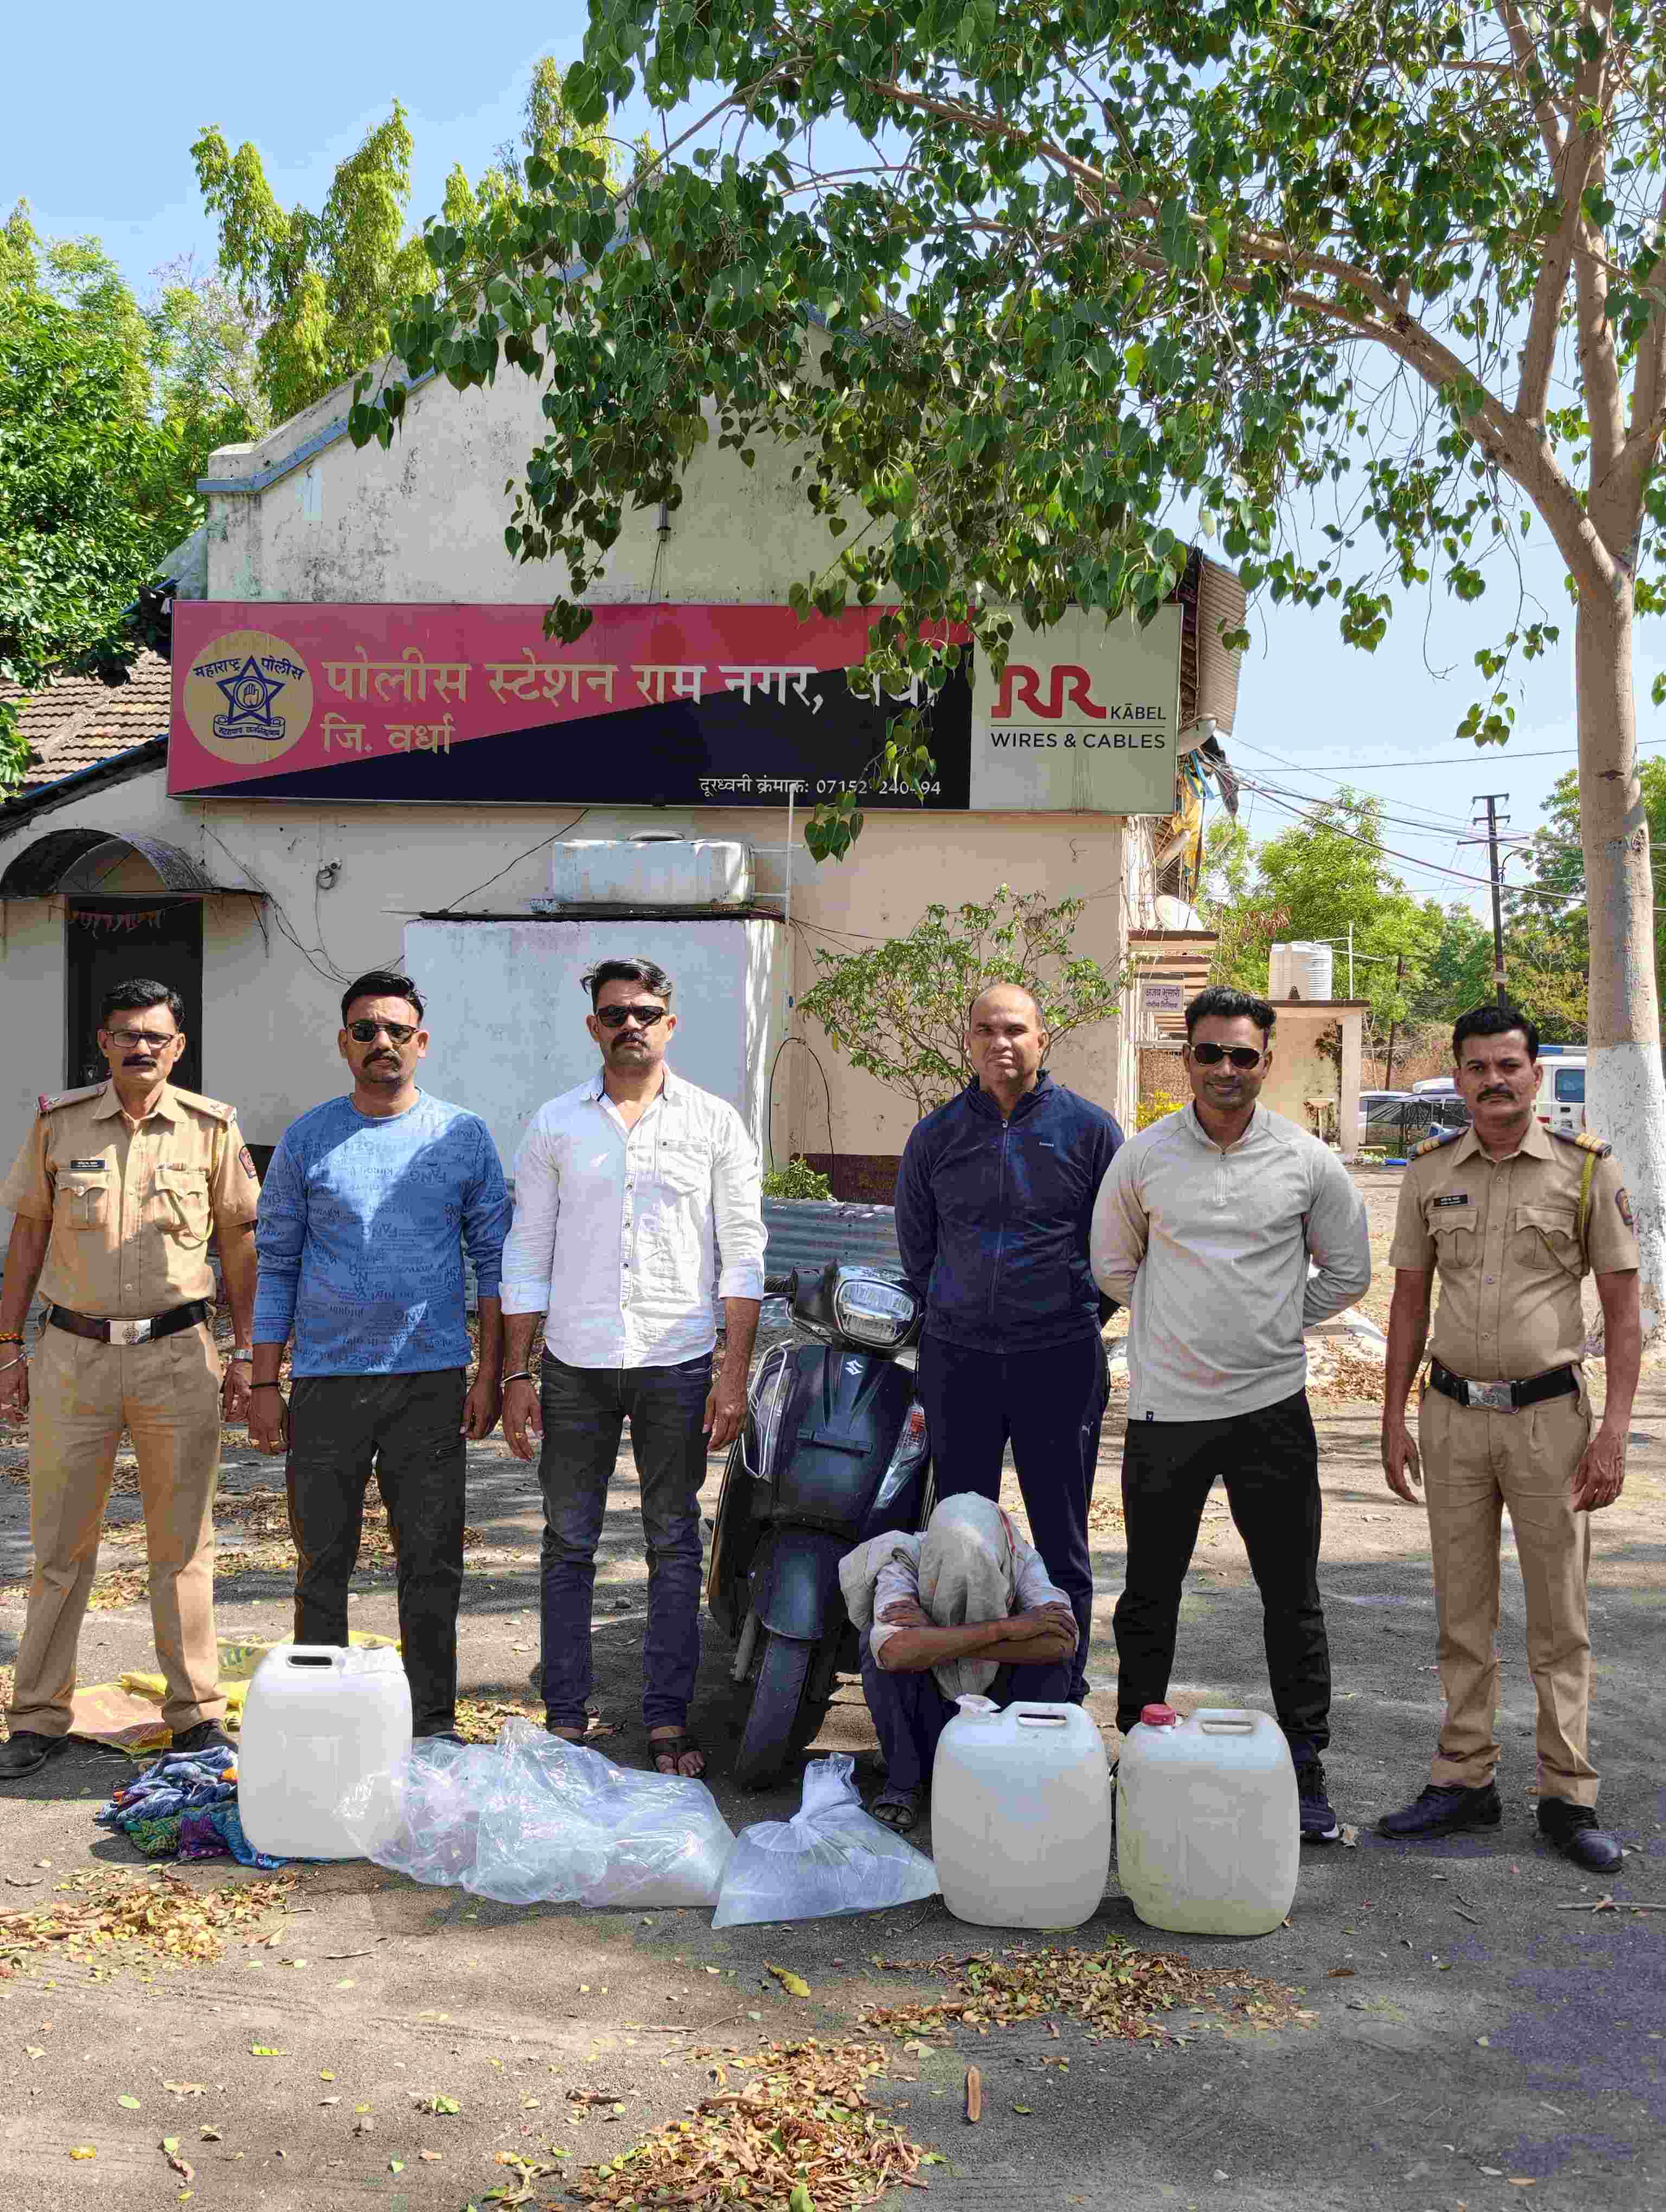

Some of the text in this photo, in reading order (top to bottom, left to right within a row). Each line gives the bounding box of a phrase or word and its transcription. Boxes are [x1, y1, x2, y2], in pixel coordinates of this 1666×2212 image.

[261, 655, 305, 680] पोलीस
[321, 646, 471, 703] पोलीस
[483, 647, 620, 707] स्टेशन
[630, 665, 707, 704] राम
[719, 665, 824, 715] नगर,
[991, 664, 1107, 719] RR
[321, 712, 456, 755] जि. वर्धा
[991, 733, 1165, 749] WIRES & CABLES
[699, 774, 752, 797] दूरध्वनी
